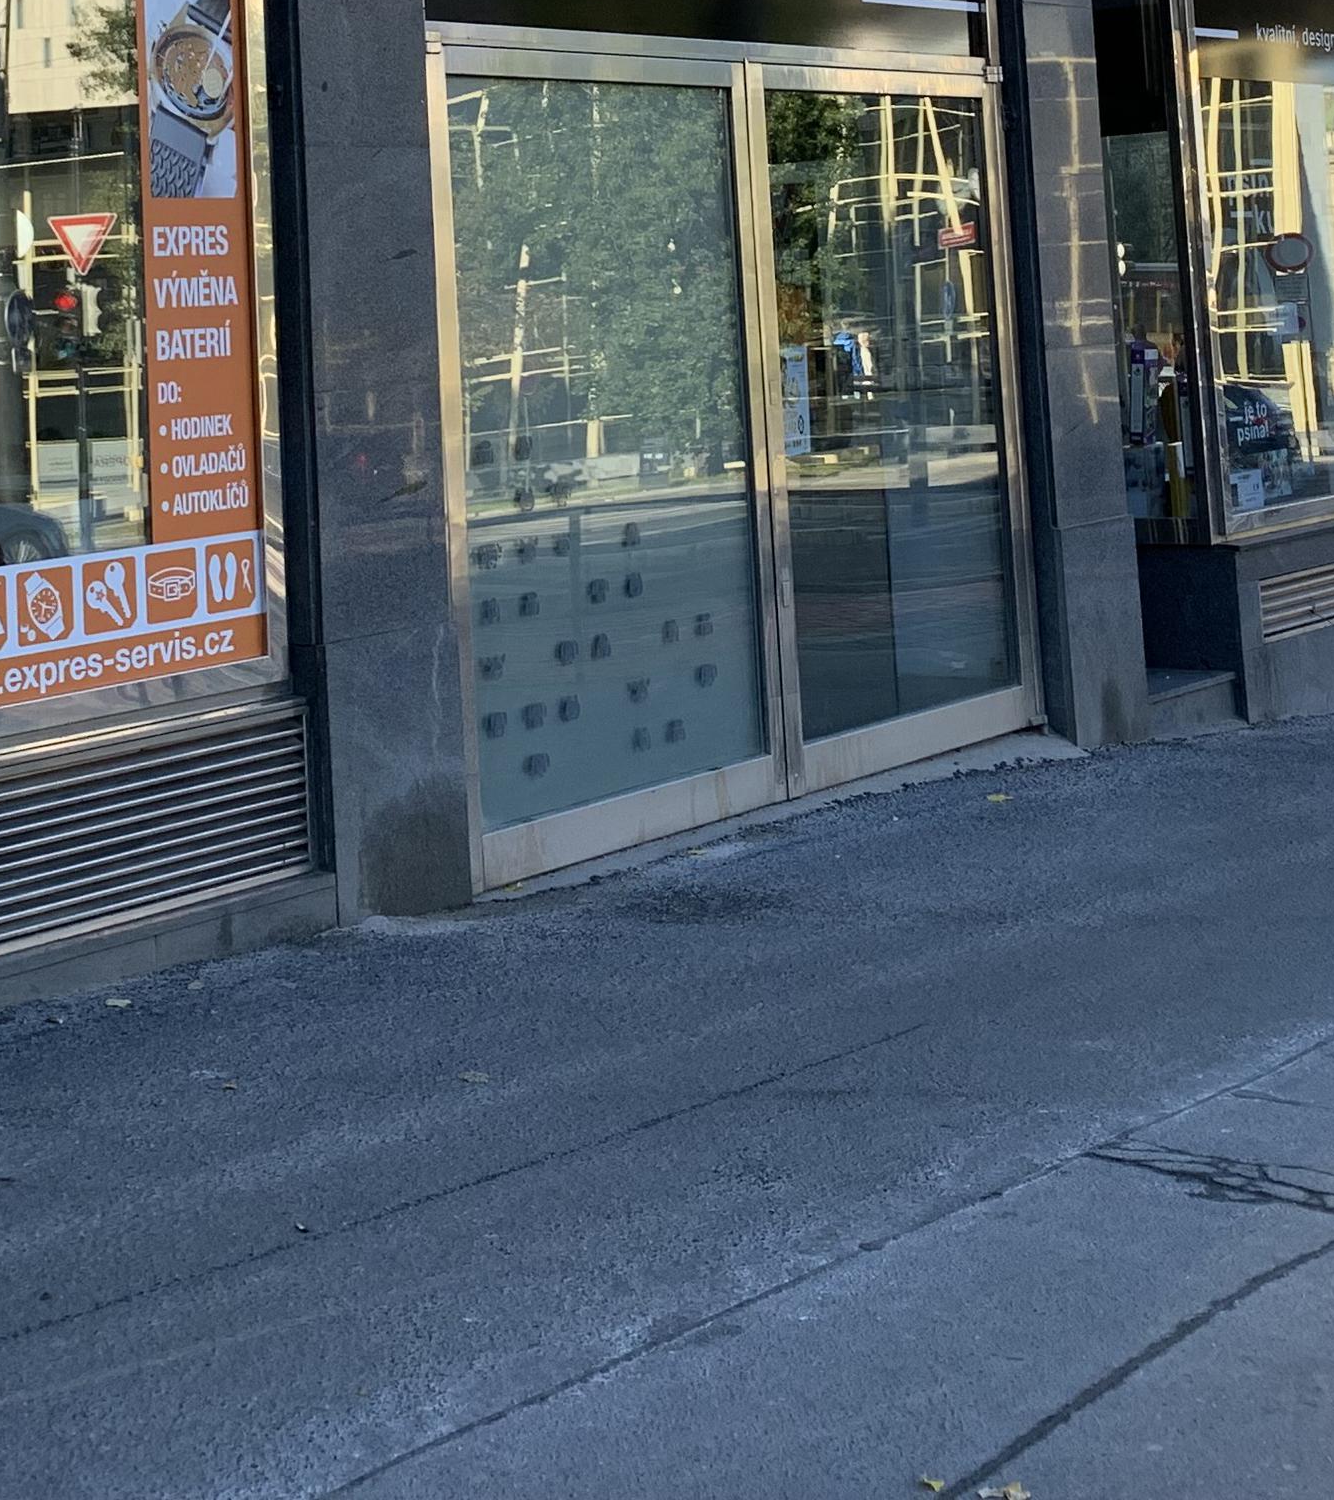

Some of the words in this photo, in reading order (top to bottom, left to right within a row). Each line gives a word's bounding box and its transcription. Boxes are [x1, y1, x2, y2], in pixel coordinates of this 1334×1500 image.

[152, 225, 229, 257] EXPRES
[153, 269, 238, 309] VÝMĚNA
[156, 319, 232, 361] BATERIÍ
[157, 381, 182, 404] DO:
[171, 413, 234, 441] HODINEK
[1243, 401, 1255, 425] je
[1255, 401, 1267, 418] to
[172, 443, 246, 478] OVLADAČŮ
[173, 479, 249, 516] AUTOKLÍČŮ
